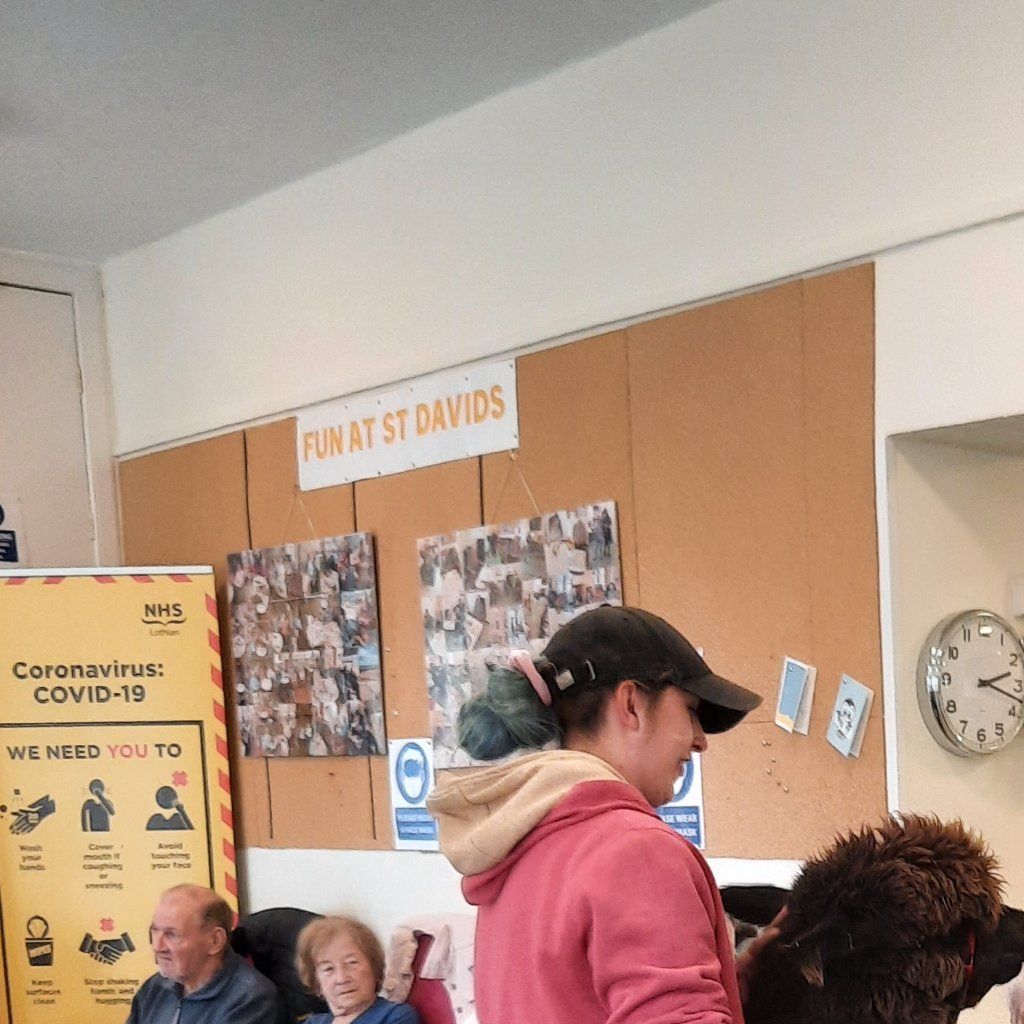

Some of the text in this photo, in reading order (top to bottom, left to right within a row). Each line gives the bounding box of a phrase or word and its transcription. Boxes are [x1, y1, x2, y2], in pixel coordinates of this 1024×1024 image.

[303, 384, 507, 462] FUN AT ST DAVIDS
[145, 603, 183, 617] NHS
[962, 624, 971, 642] 11
[948, 646, 959, 660] 10
[1009, 653, 1018, 667] 2
[12, 660, 164, 680] Coronavirus:
[941, 672, 952, 686] 9
[1013, 679, 1023, 693] 3
[33, 685, 146, 704] COVID-19
[946, 700, 957, 713] 8
[1008, 705, 1017, 718] 4
[959, 720, 969, 734] 7
[994, 722, 1005, 737] 5
[976, 728, 987, 743] 6
[7, 743, 183, 760] WE NEED YOU TO
[676, 813, 697, 823] WEAR
[151, 853, 191, 861] touching
[151, 862, 171, 870] your
